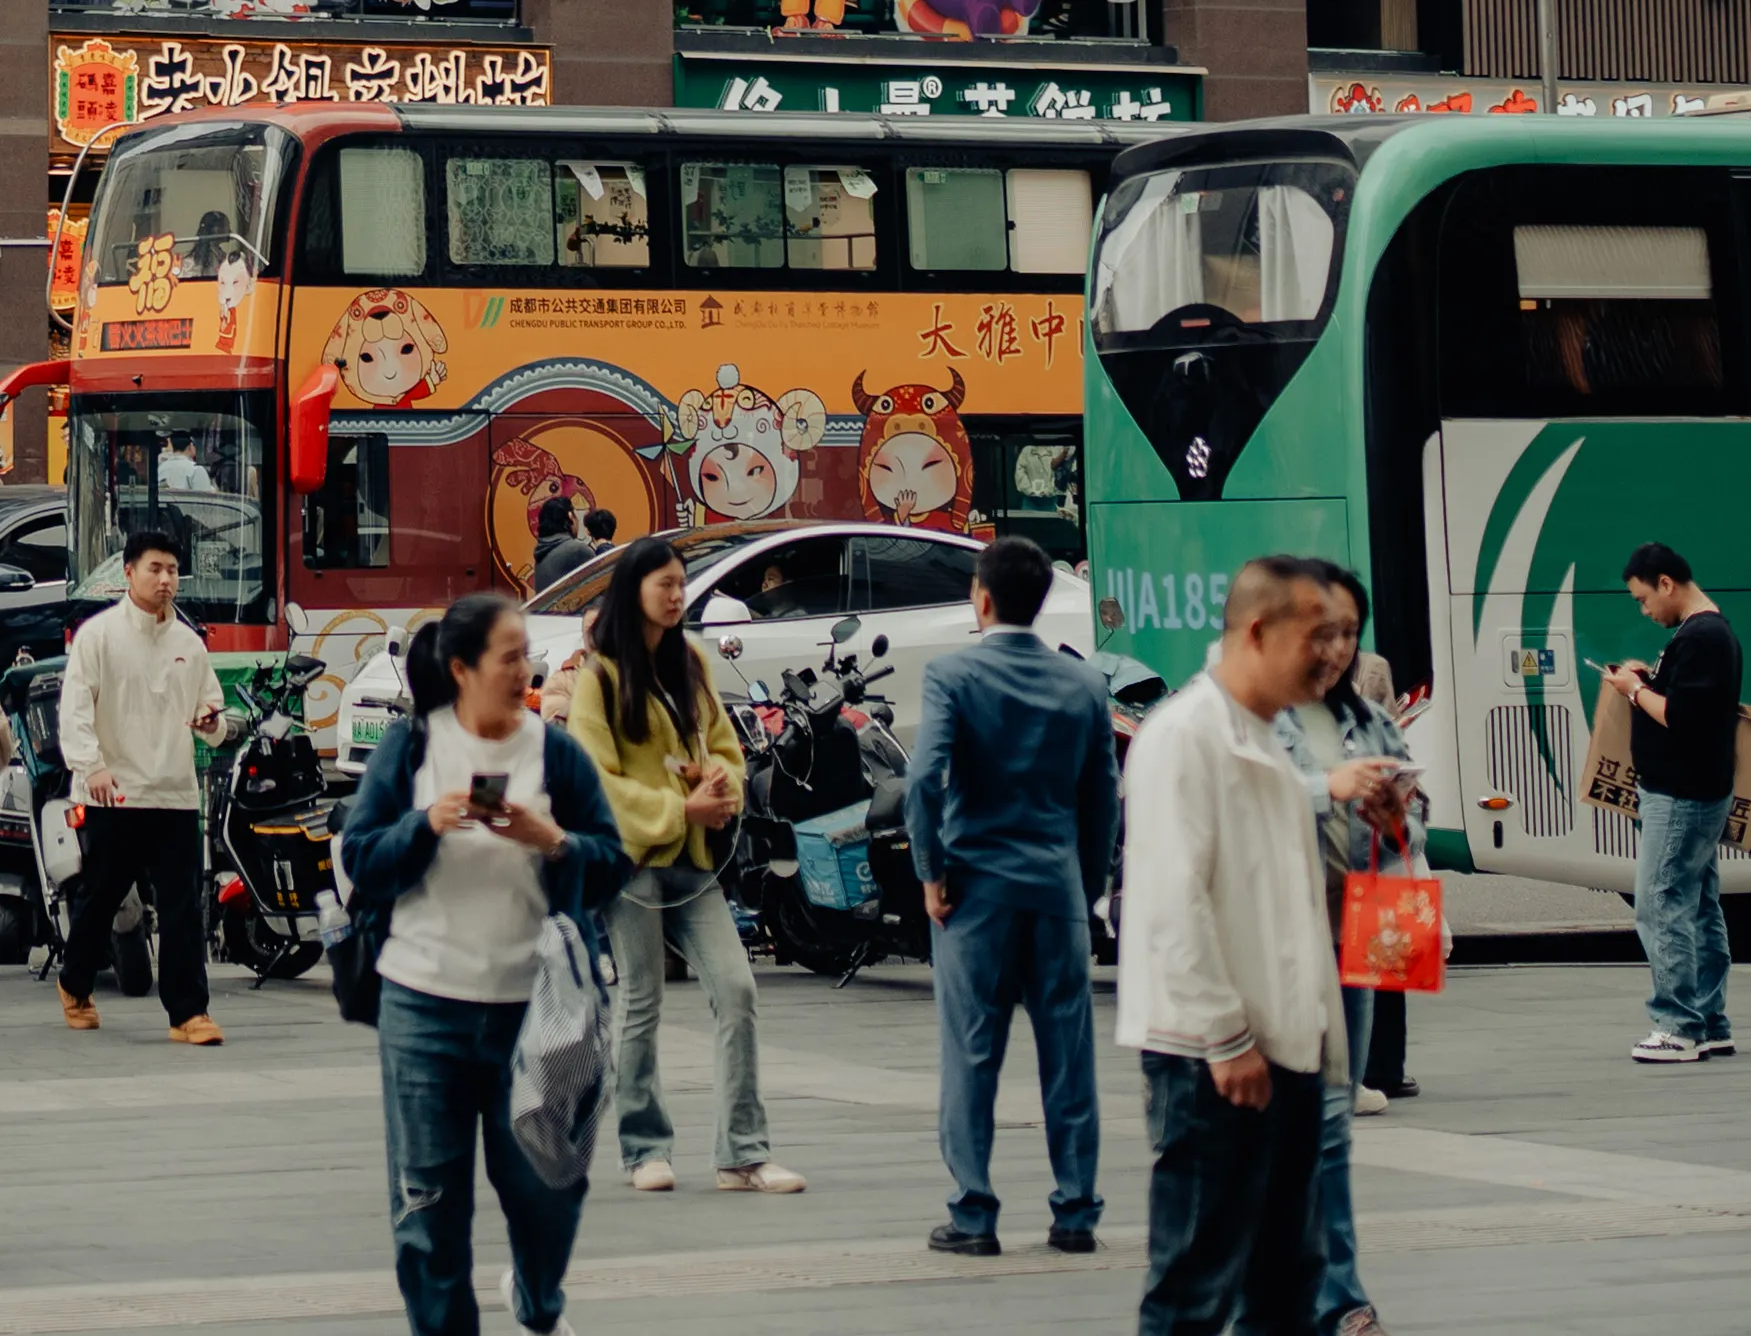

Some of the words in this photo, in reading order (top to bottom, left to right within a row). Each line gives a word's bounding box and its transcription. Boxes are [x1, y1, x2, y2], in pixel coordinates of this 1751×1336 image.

[128, 232, 175, 316] 福
[509, 297, 687, 316] 成都市公共交通集团有限公司
[509, 319, 548, 329] CHENGDU
[549, 319, 576, 329] PUBLIC
[577, 319, 624, 329] TRANSPORT
[625, 319, 654, 329] GROUP
[920, 298, 1085, 371] 大雅中
